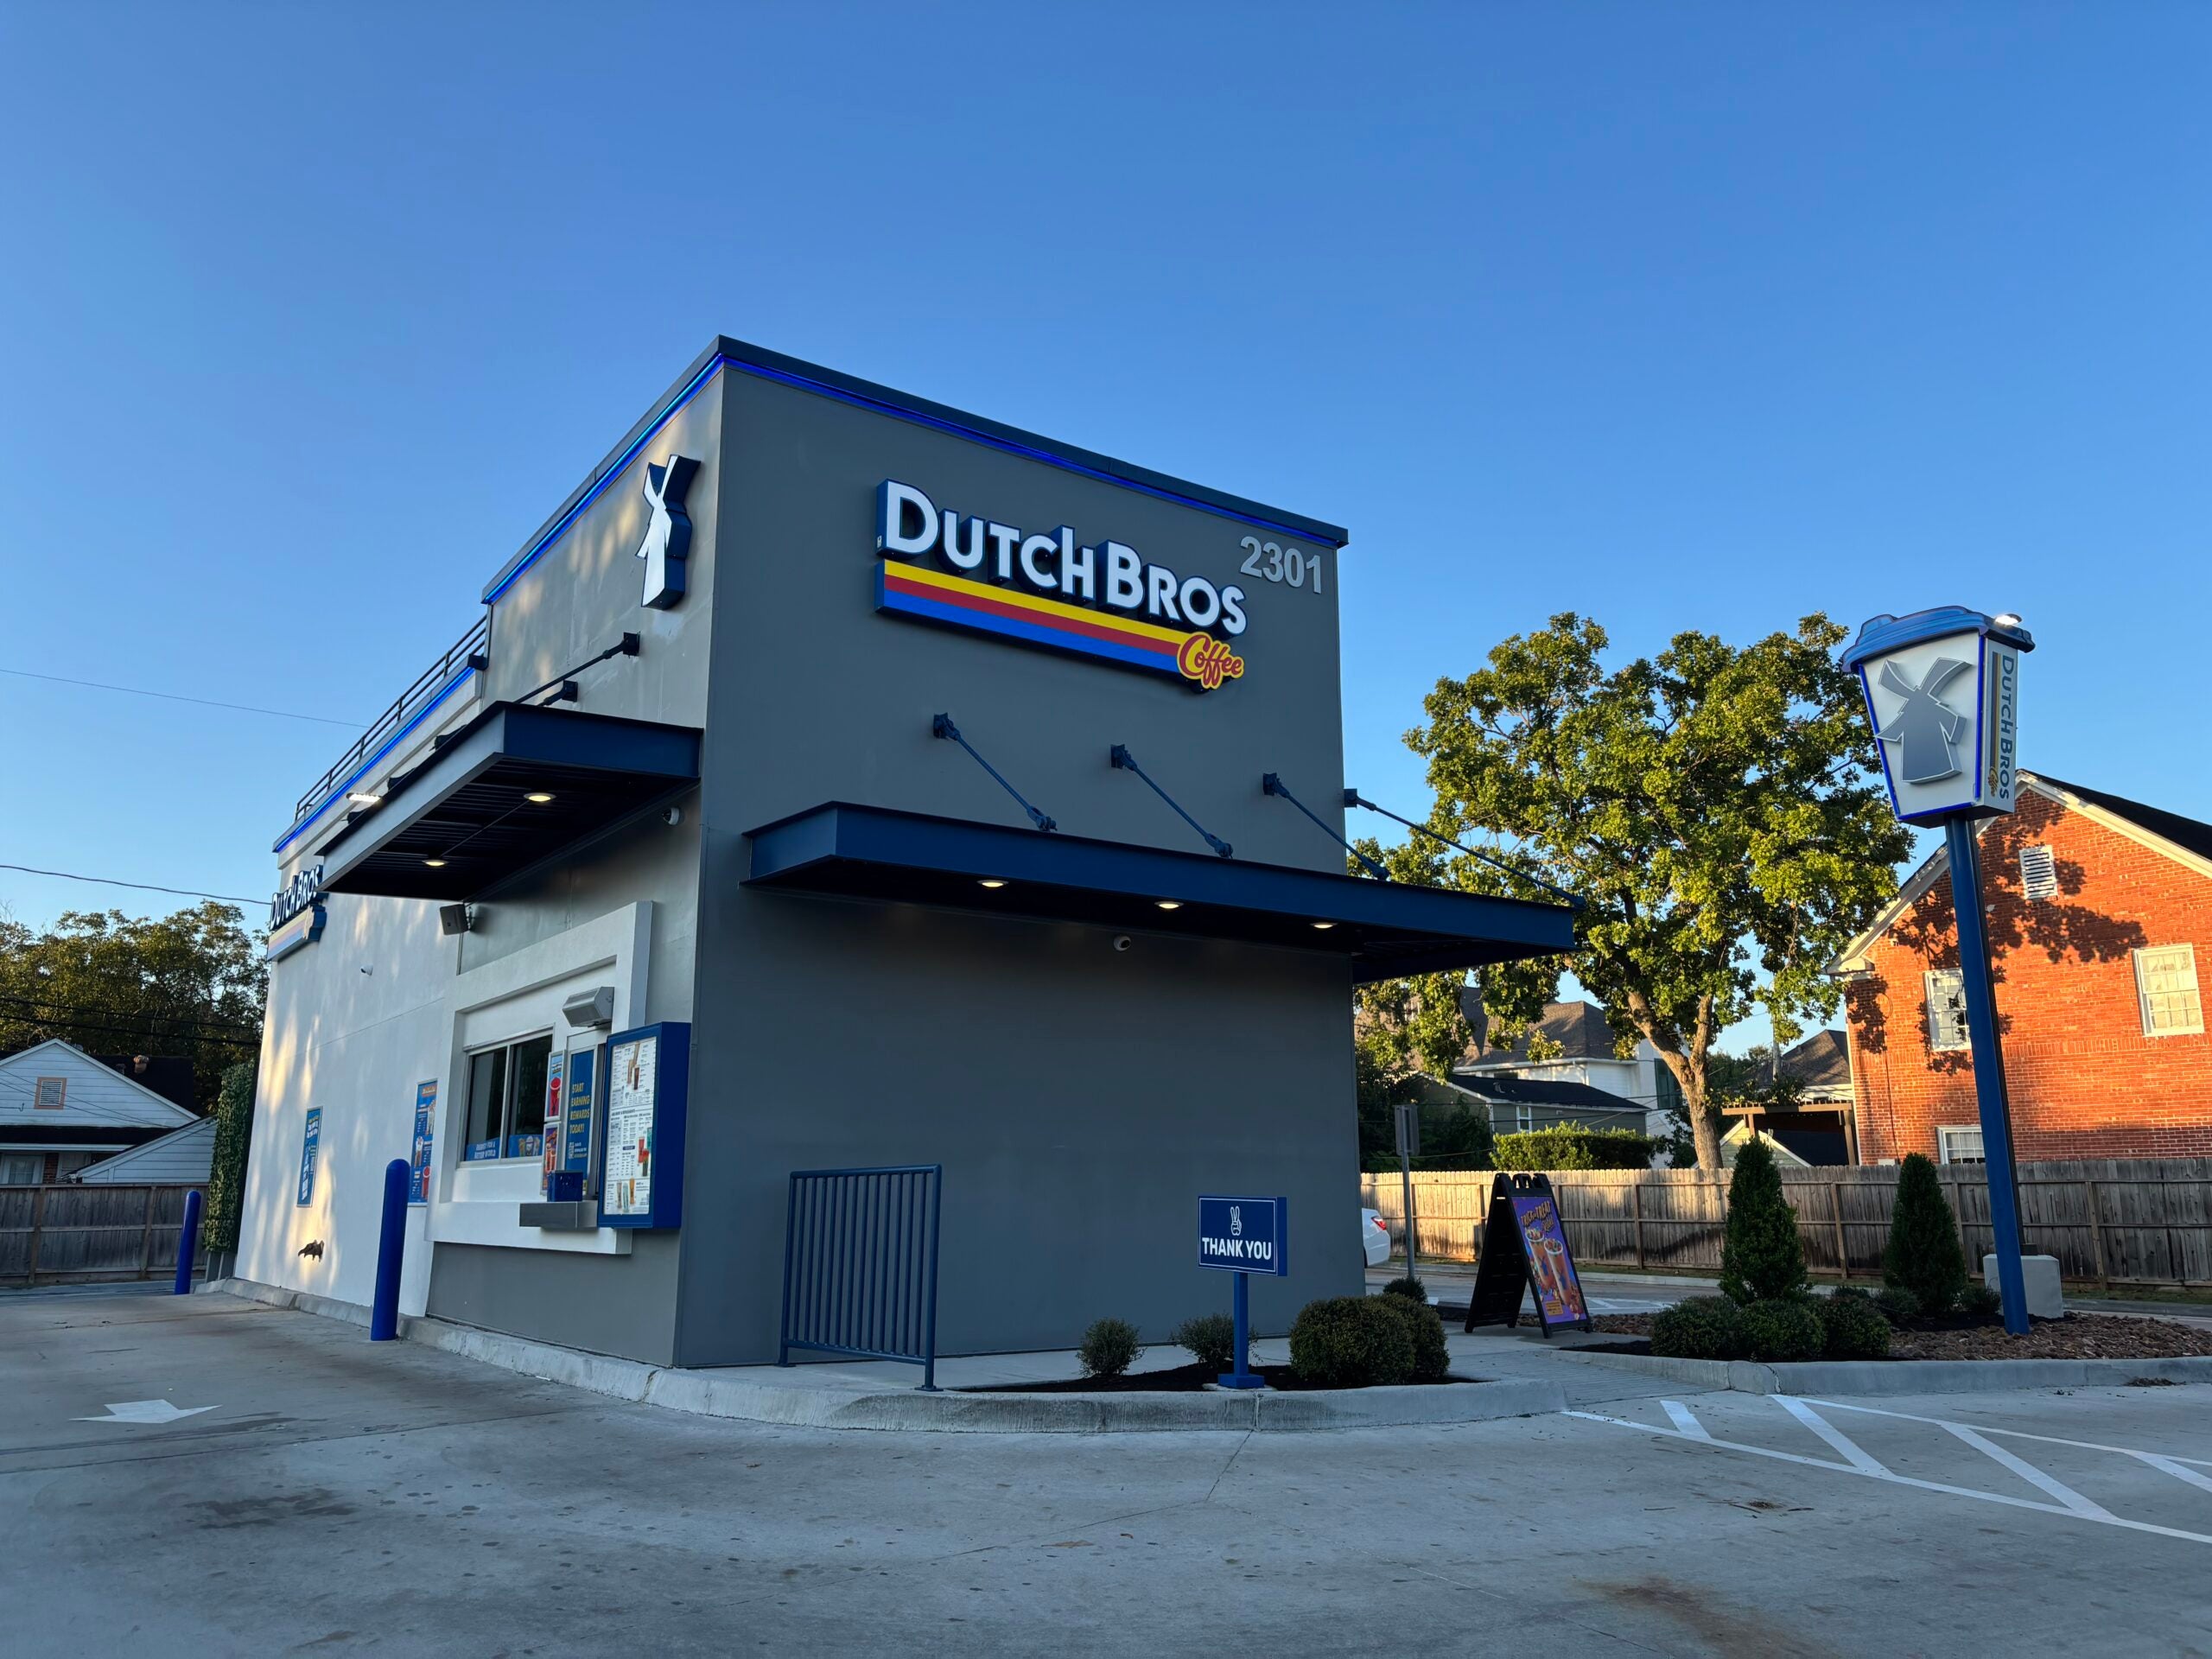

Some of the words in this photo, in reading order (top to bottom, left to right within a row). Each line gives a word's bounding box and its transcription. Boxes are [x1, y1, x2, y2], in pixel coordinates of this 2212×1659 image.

[886, 480, 1096, 602] DUTCH
[1106, 540, 1248, 635] BROS
[1240, 536, 1322, 594] 2301
[1179, 633, 1243, 687] Coffee
[2000, 654, 2014, 734] DUTCH
[1999, 737, 2013, 800] BROS
[270, 874, 298, 931] DUTCH
[570, 1109, 590, 1121] REWARDS
[1202, 1237, 1243, 1258] THANK
[1245, 1241, 1272, 1261] YOU
